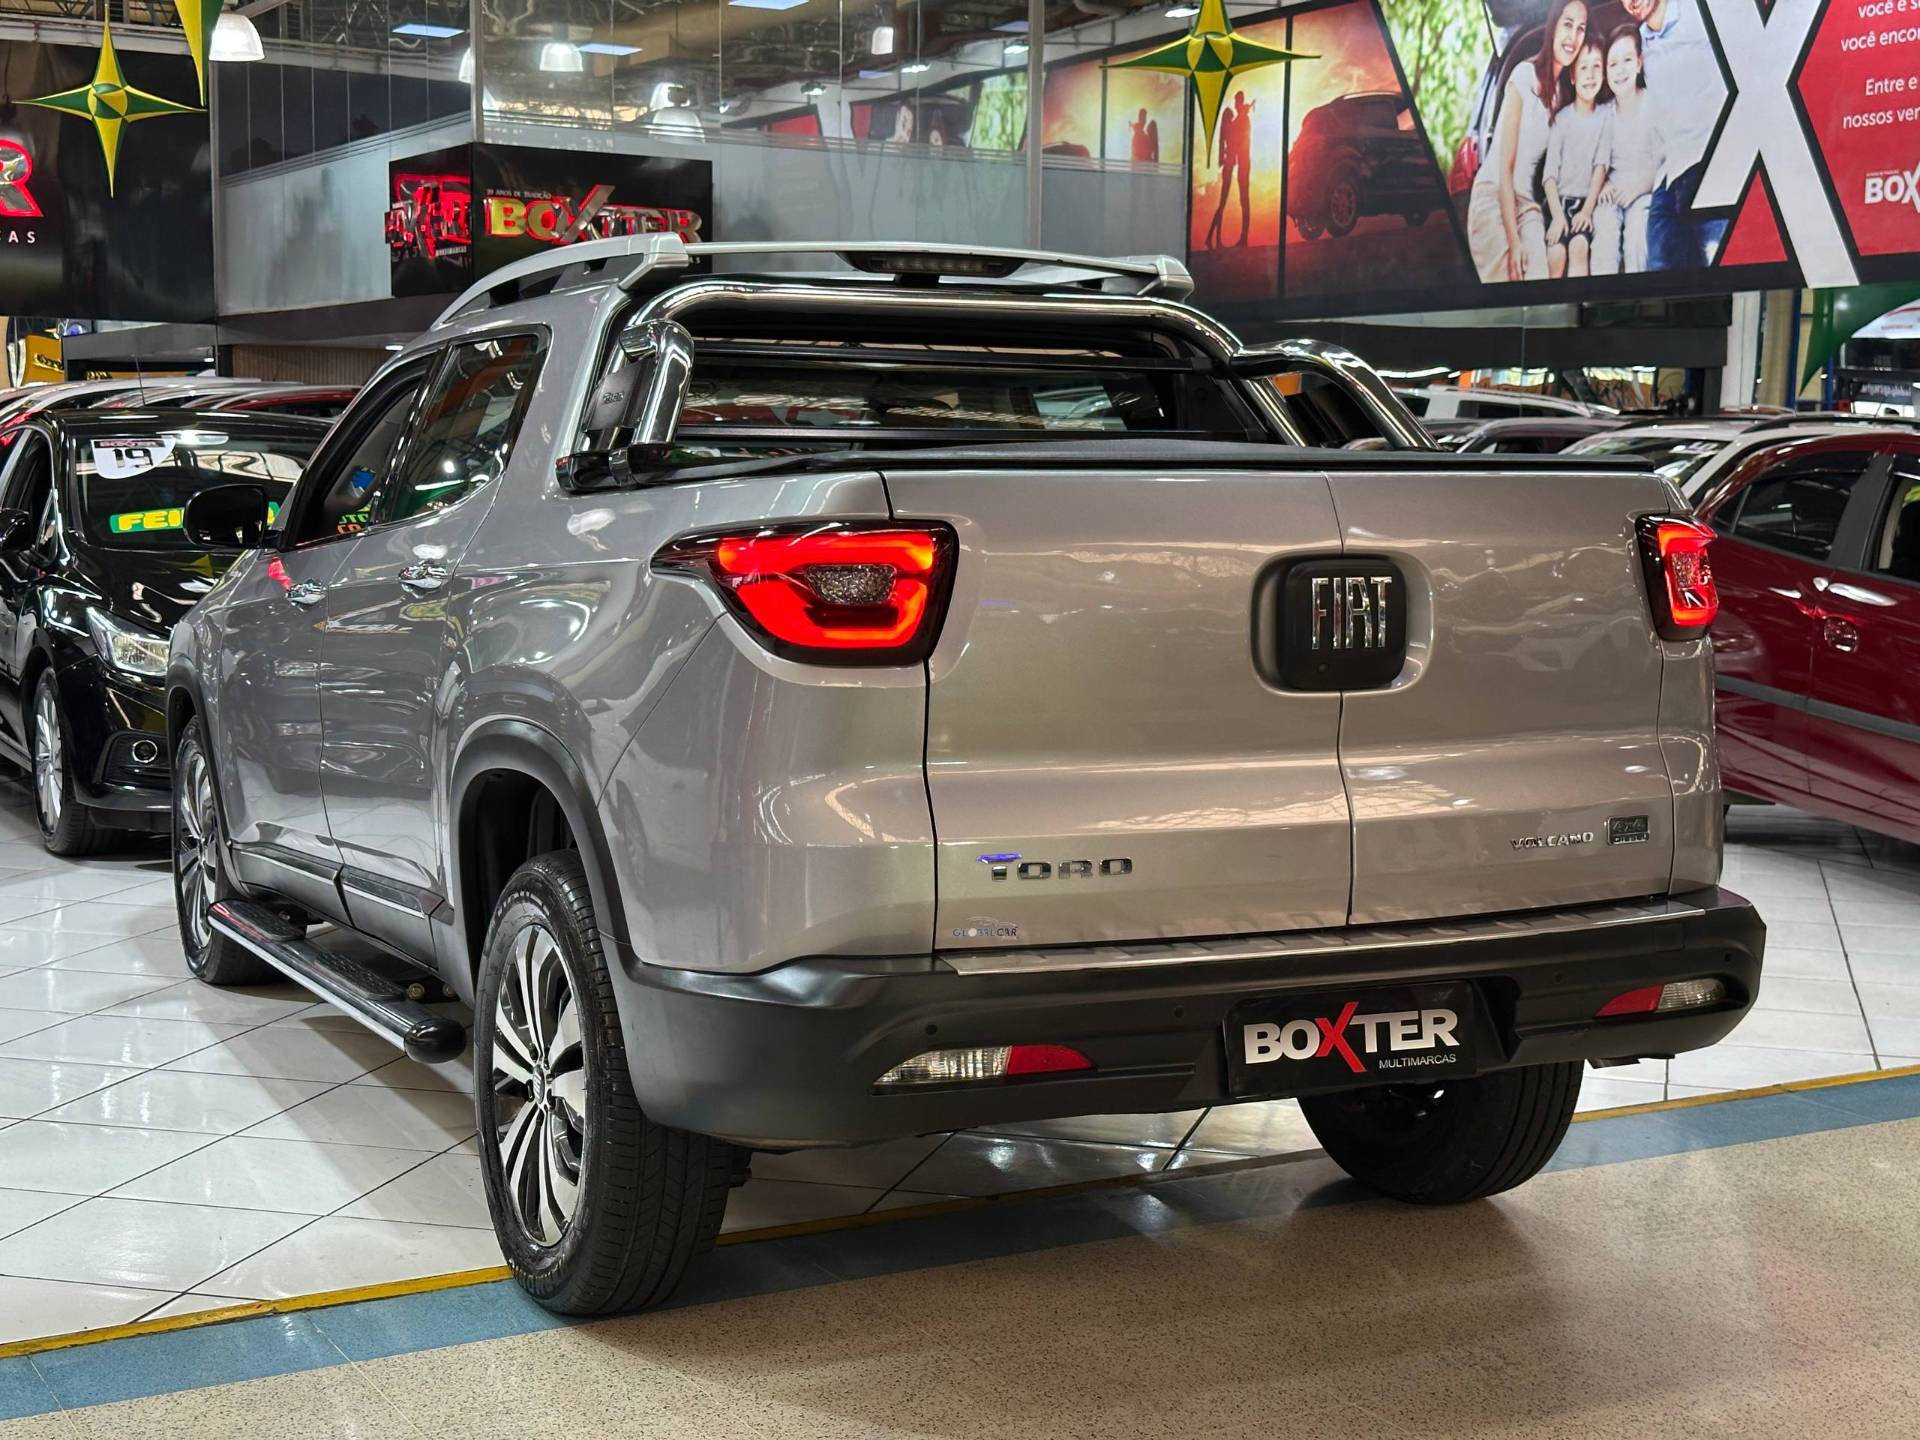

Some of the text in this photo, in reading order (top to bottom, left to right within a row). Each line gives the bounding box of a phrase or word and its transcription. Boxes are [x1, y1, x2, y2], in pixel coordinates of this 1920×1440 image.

[1910, 0, 1920, 10] s
[1841, 27, 1920, 52] você enco
[1865, 78, 1905, 96] Entre
[1843, 110, 1894, 129] nossos
[0, 230, 36, 244] AS
[1312, 576, 1393, 649] FIAT
[1511, 831, 1594, 851] VOLCANO
[976, 852, 1134, 881] TORO
[1243, 1001, 1460, 1073] BOXTER
[1379, 1053, 1457, 1069] MULTIMARCAS
